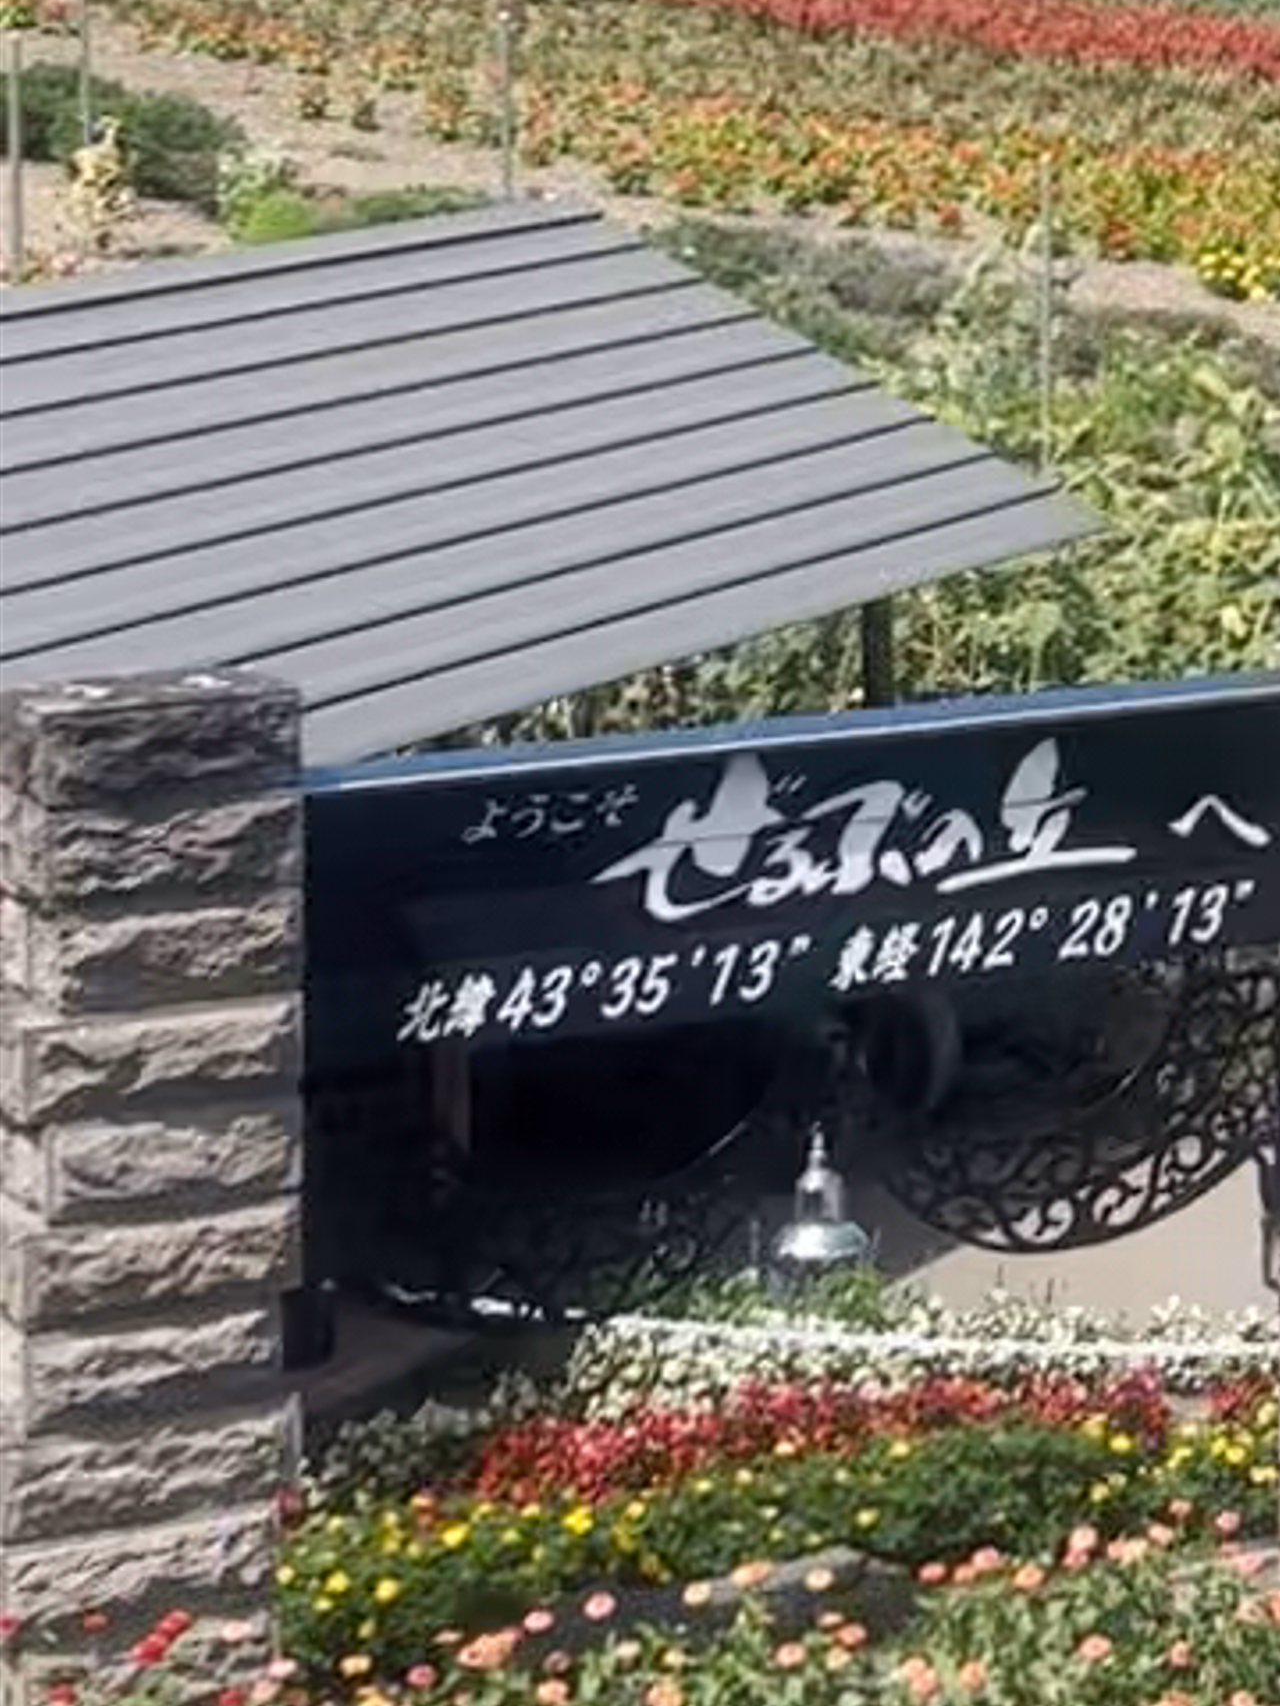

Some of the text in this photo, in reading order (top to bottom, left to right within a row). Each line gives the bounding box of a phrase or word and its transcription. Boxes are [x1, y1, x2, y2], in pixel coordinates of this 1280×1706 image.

[460, 782, 641, 847] ようこそ
[1167, 793, 1271, 848] へ
